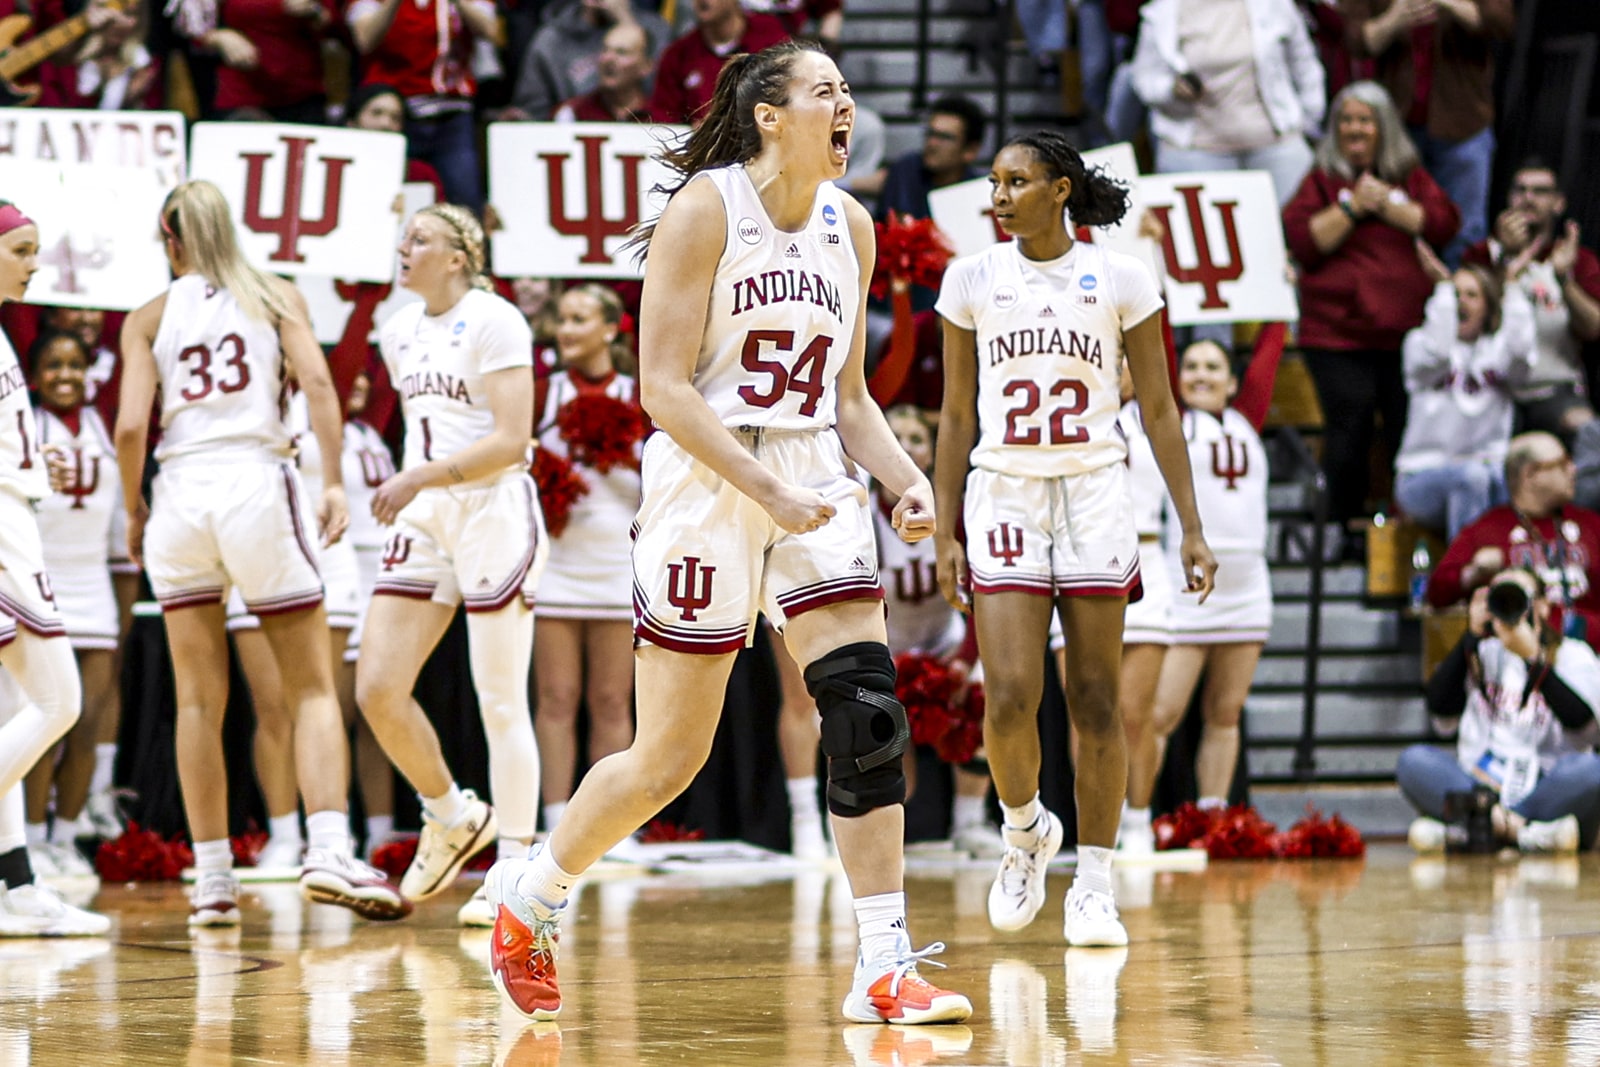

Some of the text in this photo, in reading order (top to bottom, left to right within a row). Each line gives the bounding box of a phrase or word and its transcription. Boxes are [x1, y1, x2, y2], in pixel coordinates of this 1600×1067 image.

[731, 269, 843, 324] INDIANA
[178, 332, 250, 402] 33
[737, 329, 834, 418] 54
[989, 327, 1103, 369] INDIANA
[1003, 379, 1090, 445] 22
